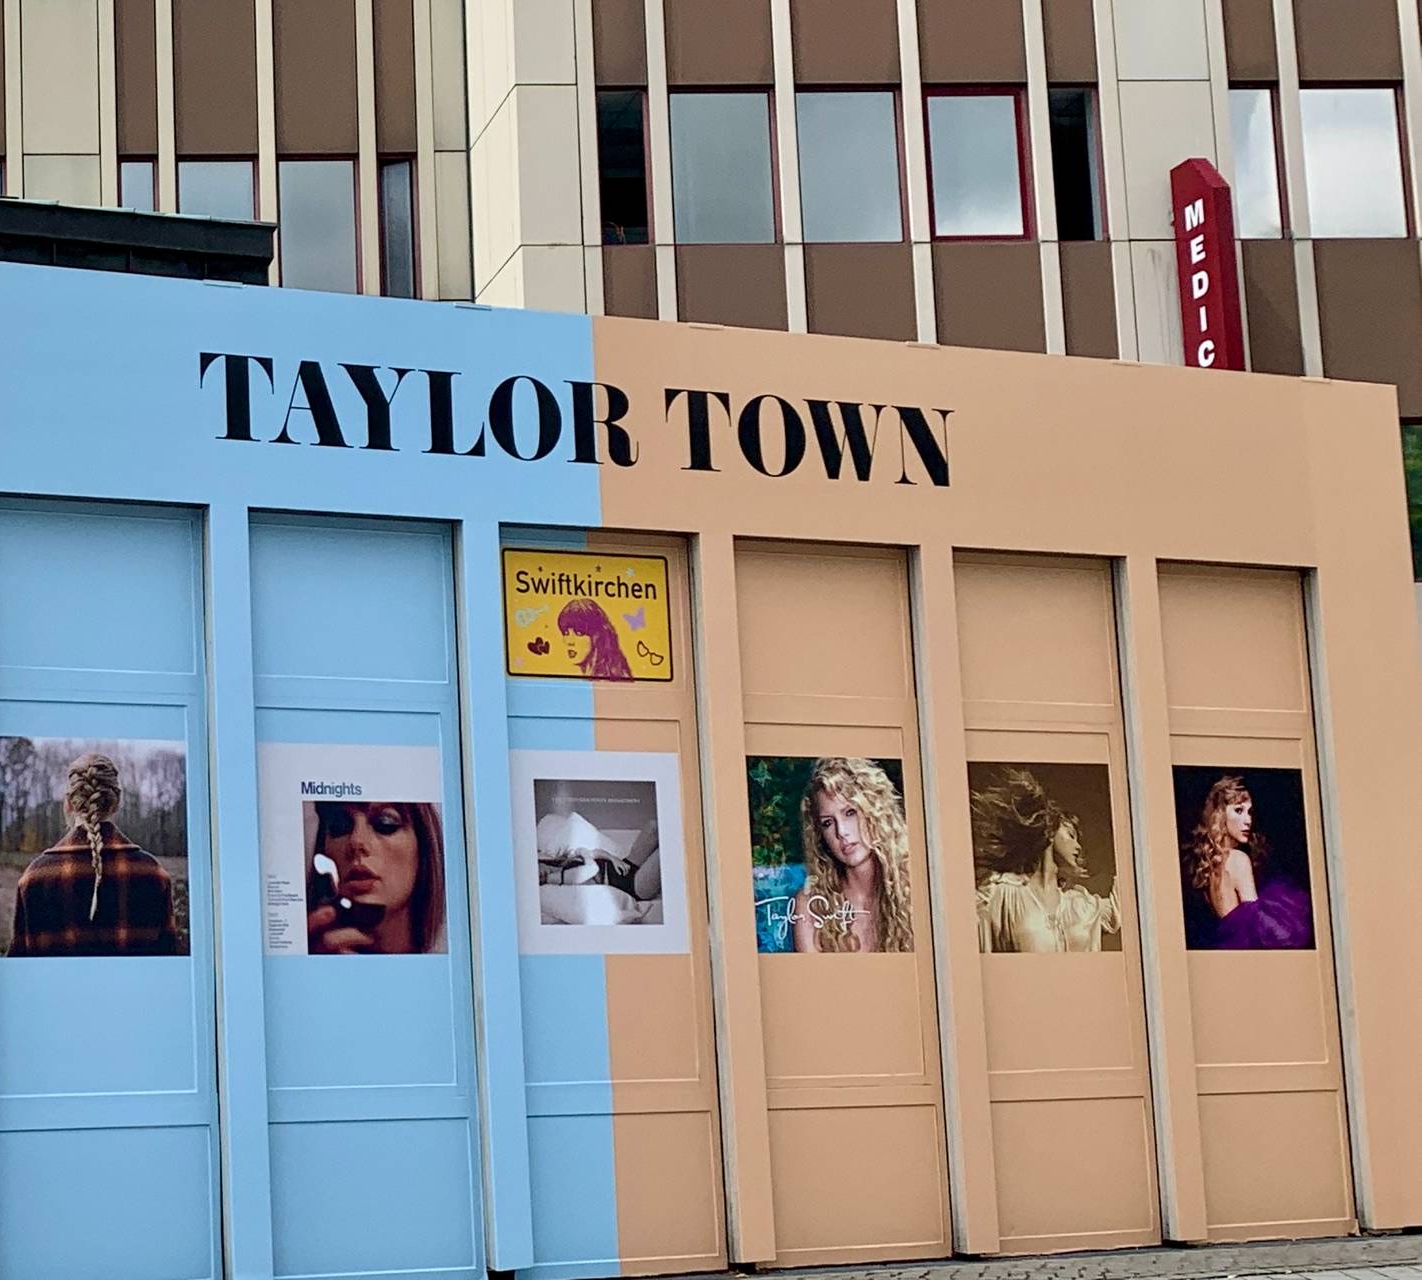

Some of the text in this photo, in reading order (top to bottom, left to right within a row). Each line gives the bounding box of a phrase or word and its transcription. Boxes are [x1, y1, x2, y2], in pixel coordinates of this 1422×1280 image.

[1184, 198, 1216, 368] MEDIC
[199, 352, 954, 487] TAYLOR TOWN
[515, 570, 658, 600] Swiftkirchen
[301, 781, 362, 798] Midnights
[755, 895, 871, 941] Taylor Swift
